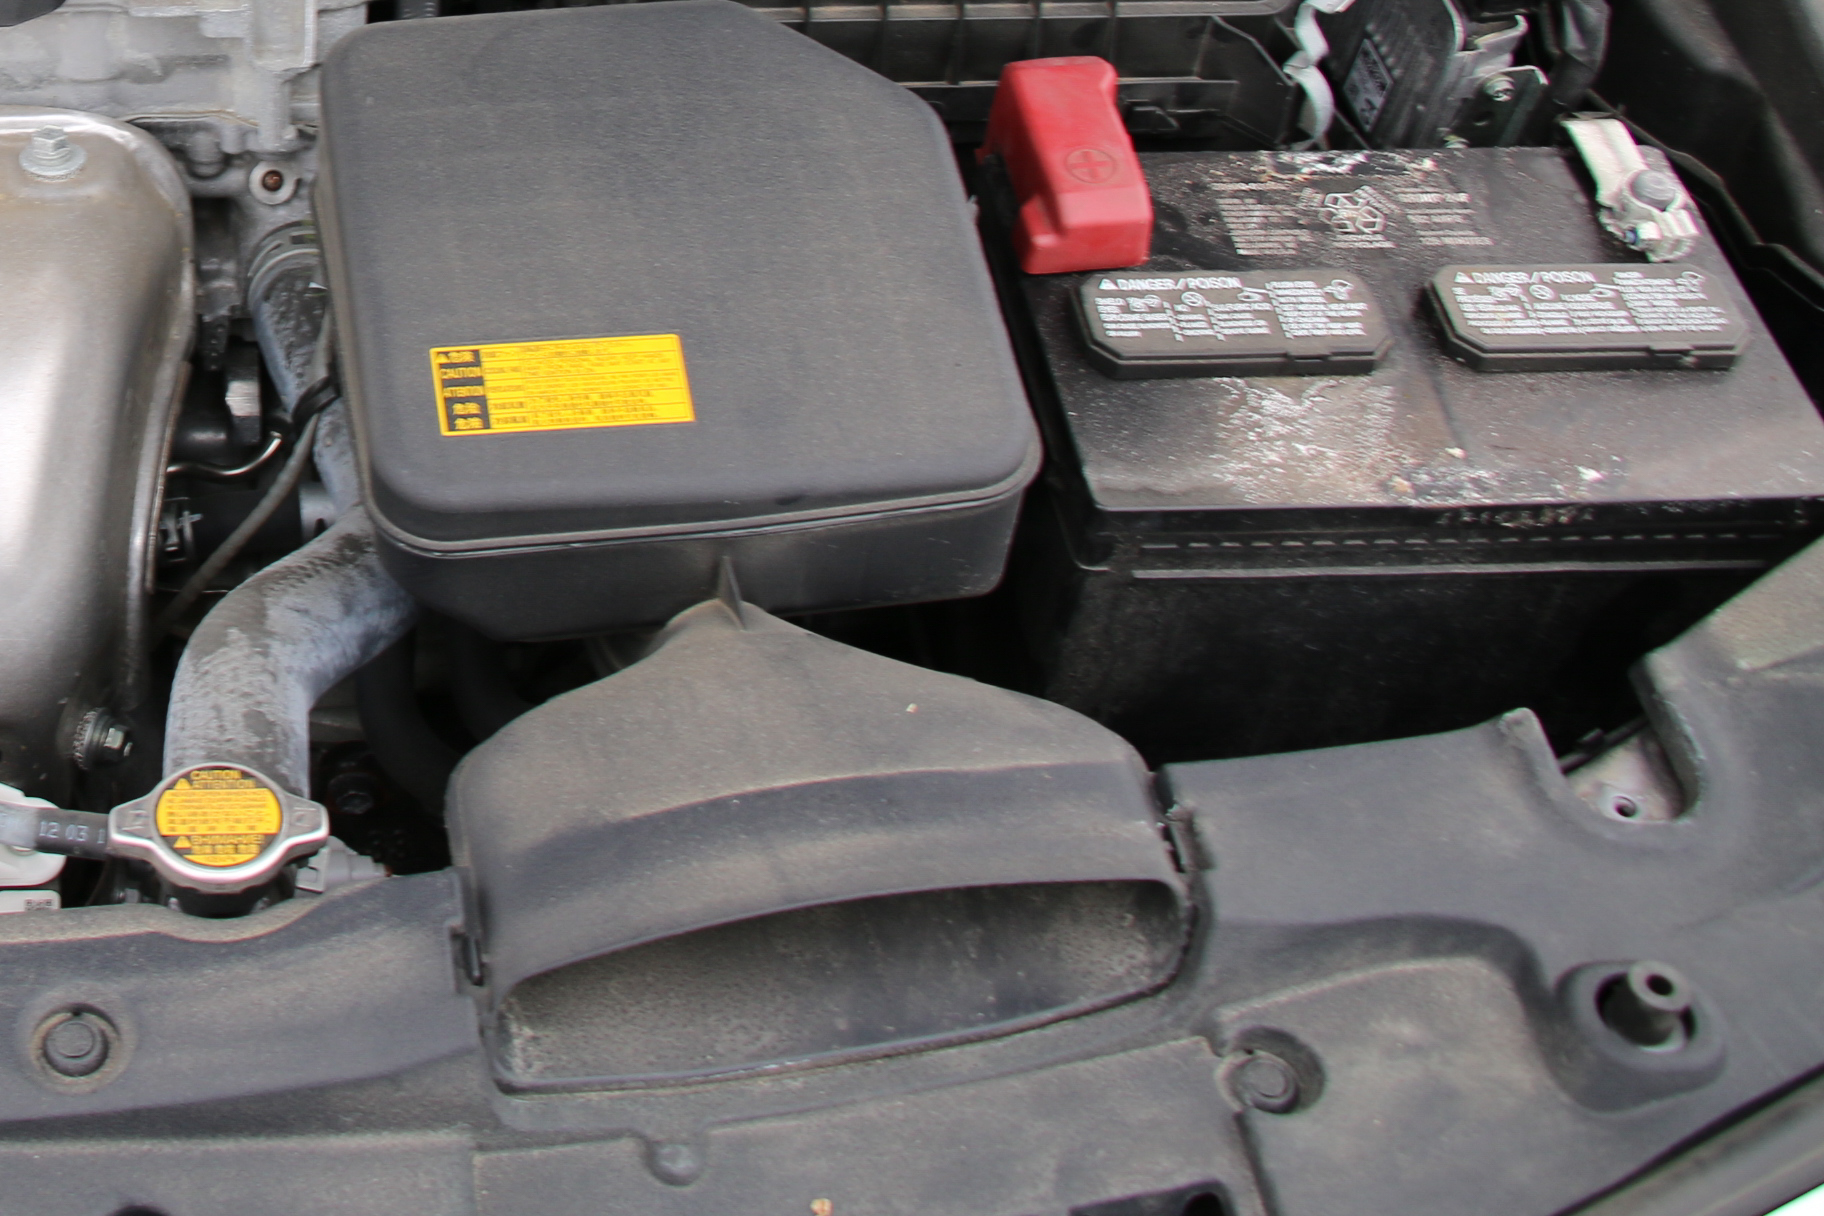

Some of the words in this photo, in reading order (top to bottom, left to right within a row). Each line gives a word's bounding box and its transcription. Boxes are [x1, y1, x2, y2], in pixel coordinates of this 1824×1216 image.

[440, 366, 482, 379] CAUTION
[190, 769, 243, 780] CAUTION
[192, 779, 257, 790] ATTENTION
[39, 820, 60, 838] 12
[65, 823, 90, 843] 03
